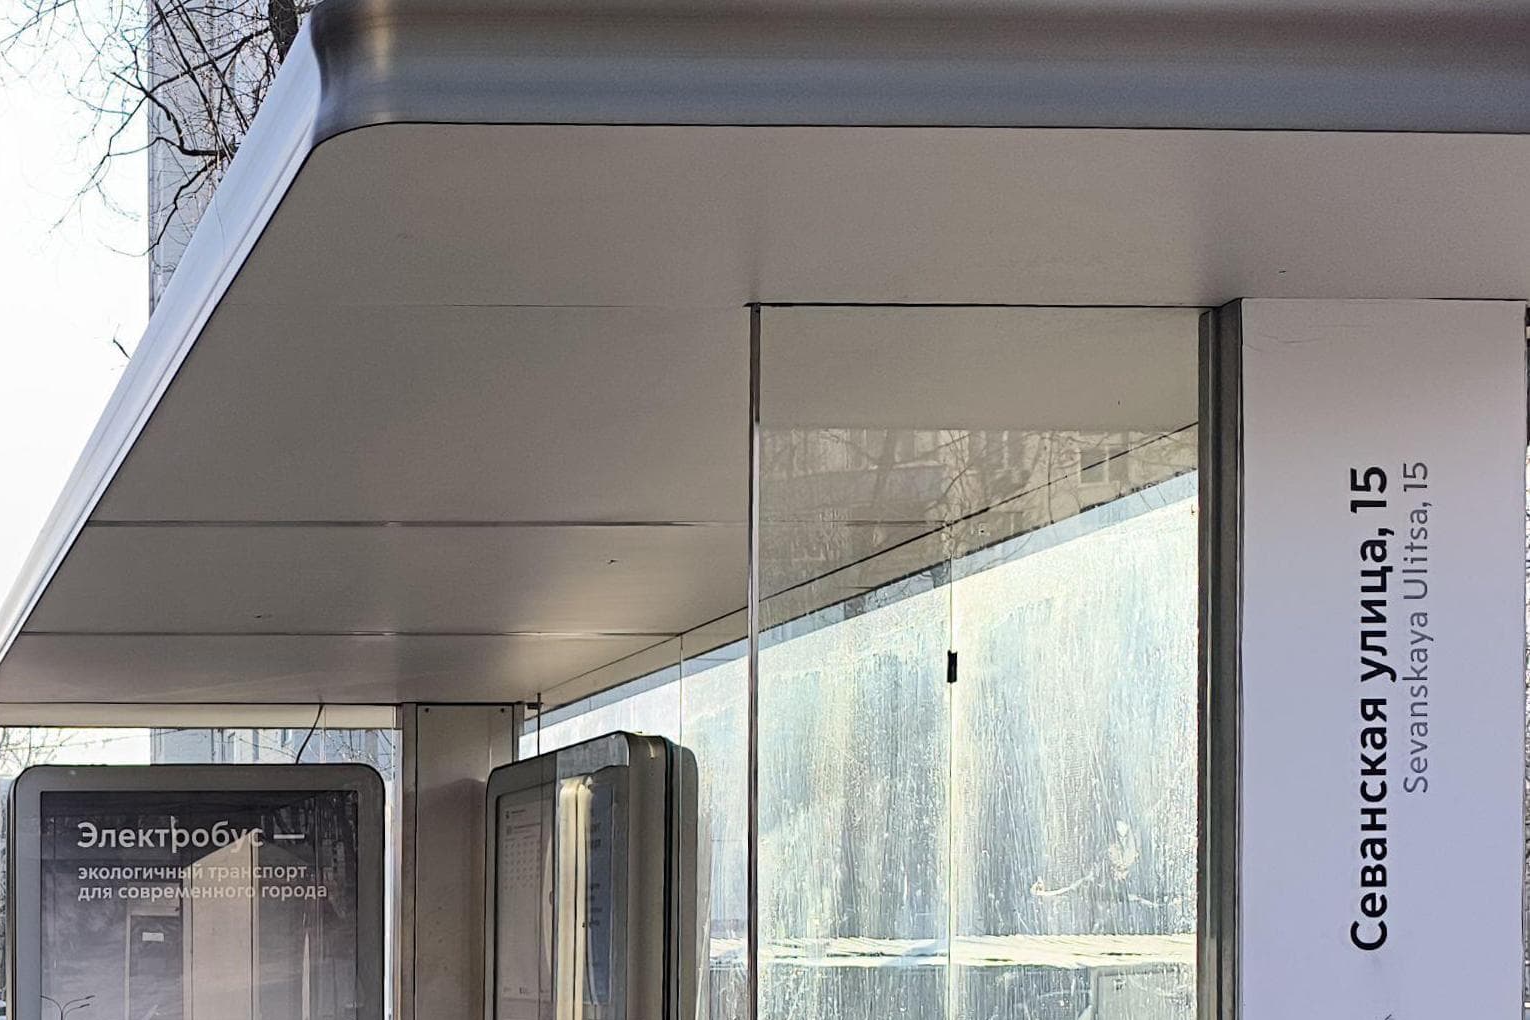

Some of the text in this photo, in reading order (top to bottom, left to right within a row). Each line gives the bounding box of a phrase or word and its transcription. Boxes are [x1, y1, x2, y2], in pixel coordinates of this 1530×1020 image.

[1401, 461, 1434, 794] Sevanskaya Ulitsa, 15
[1349, 465, 1397, 951] Севанская улица, 15
[76, 820, 265, 854] Электробус
[77, 863, 309, 882] экологичный транспорт
[77, 884, 329, 903] для современного города
